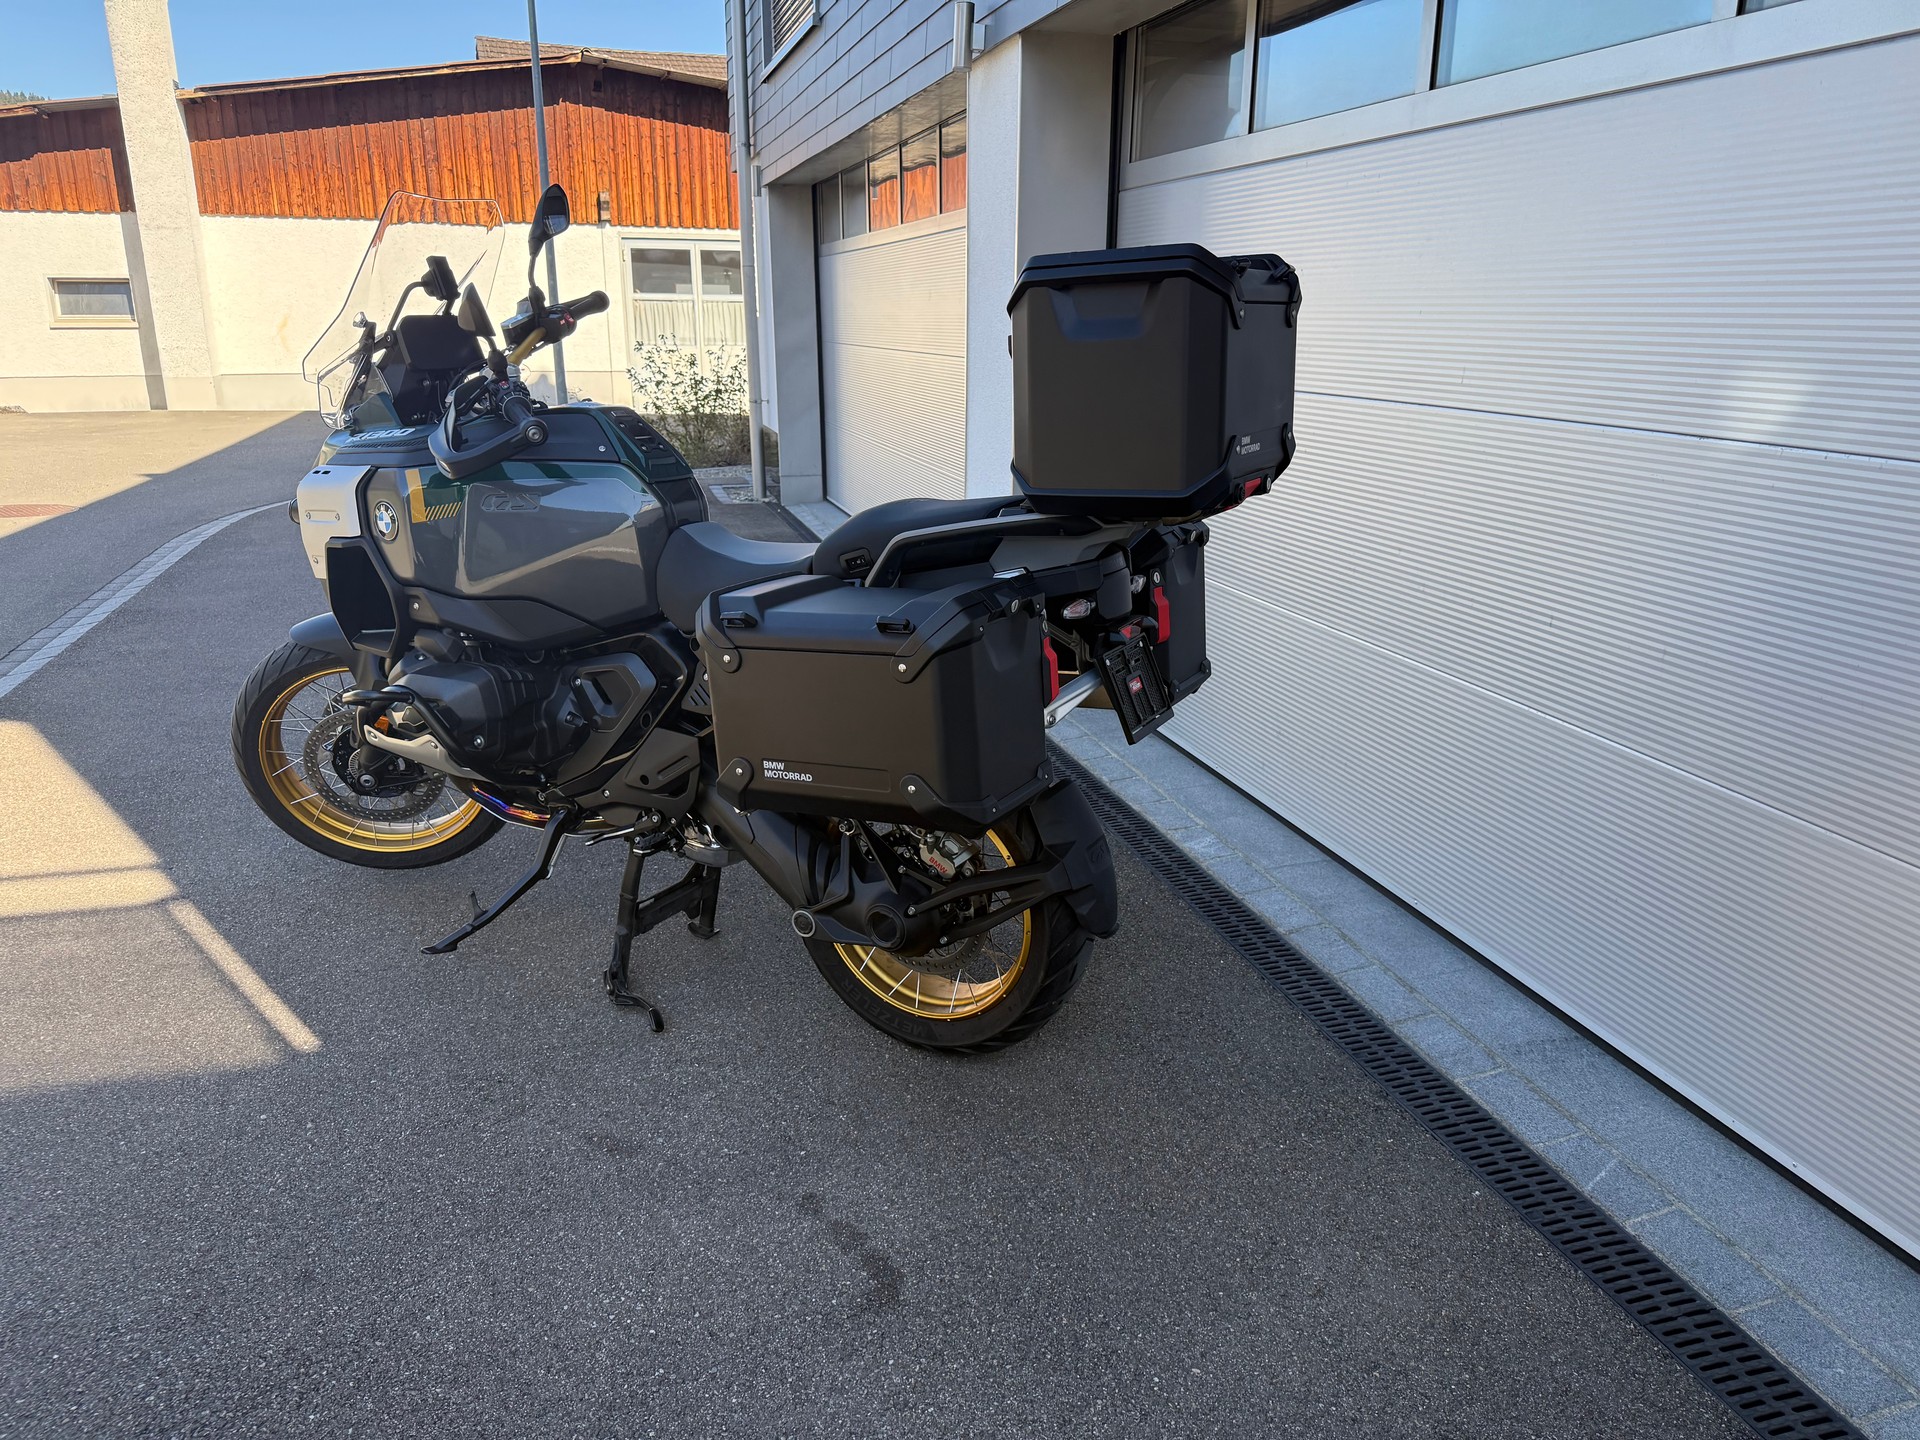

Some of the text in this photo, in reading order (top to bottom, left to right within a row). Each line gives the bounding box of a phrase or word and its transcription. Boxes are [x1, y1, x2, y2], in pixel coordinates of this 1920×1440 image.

[763, 760, 785, 770] BMW
[764, 769, 813, 782] MOTORRAD
[929, 856, 948, 873] BMW
[841, 978, 928, 1037] METZELER
